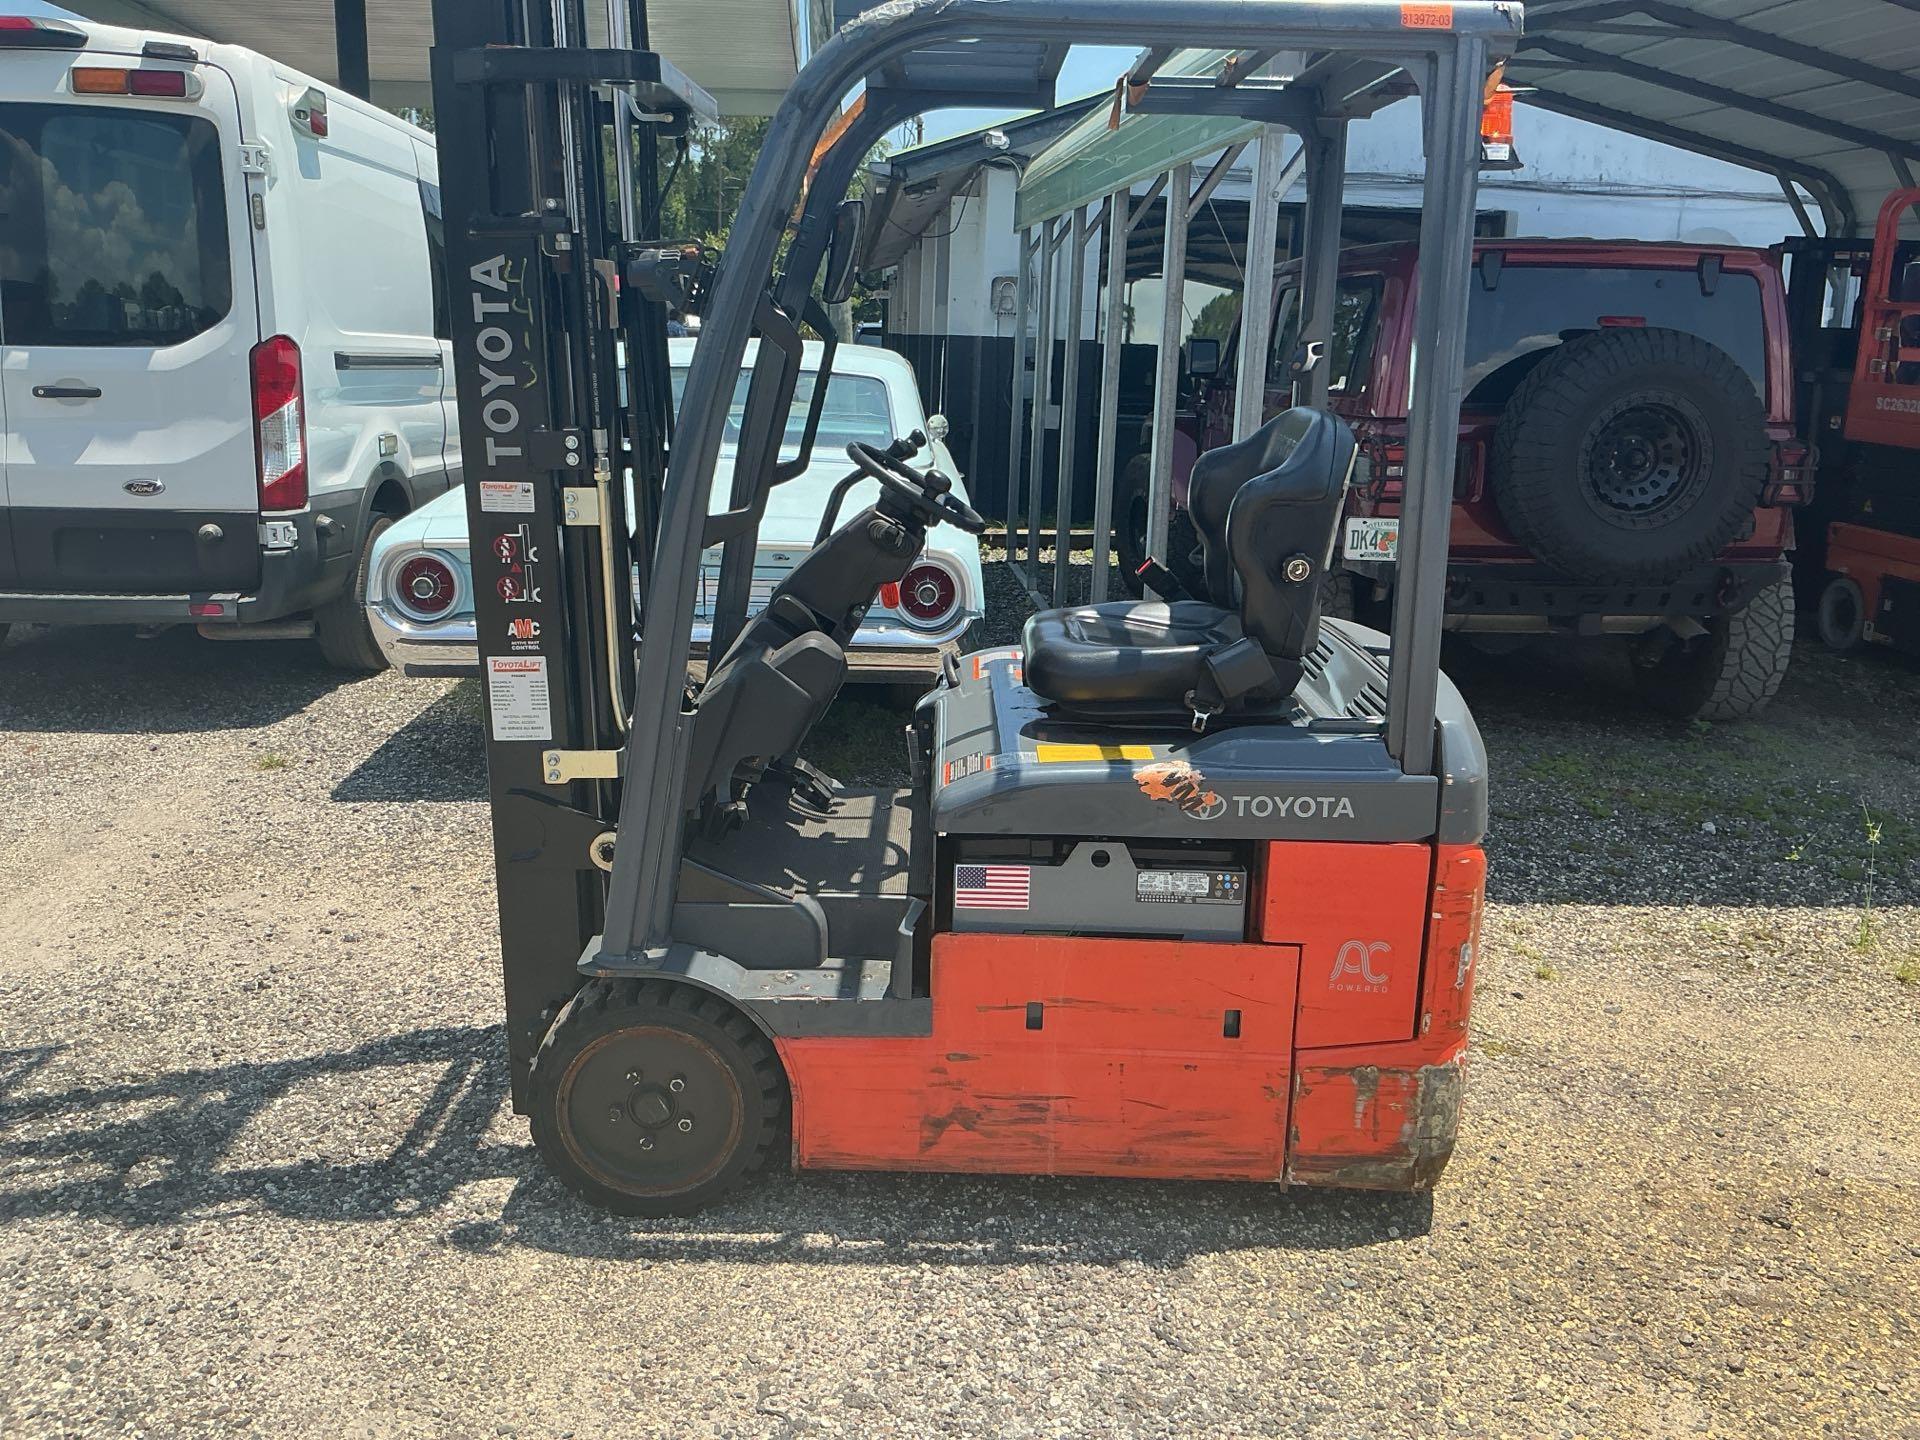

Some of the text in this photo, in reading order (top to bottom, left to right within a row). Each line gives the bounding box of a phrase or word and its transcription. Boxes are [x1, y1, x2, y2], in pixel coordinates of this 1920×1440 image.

[1402, 13, 1450, 26] 813972-03
[470, 254, 522, 466] TOYOTA
[1350, 529, 1379, 550] DK4
[507, 618, 541, 639] AMC
[1232, 795, 1355, 818] TOYOTA
[1329, 940, 1392, 984] AC
[1328, 983, 1389, 994] POWERED
